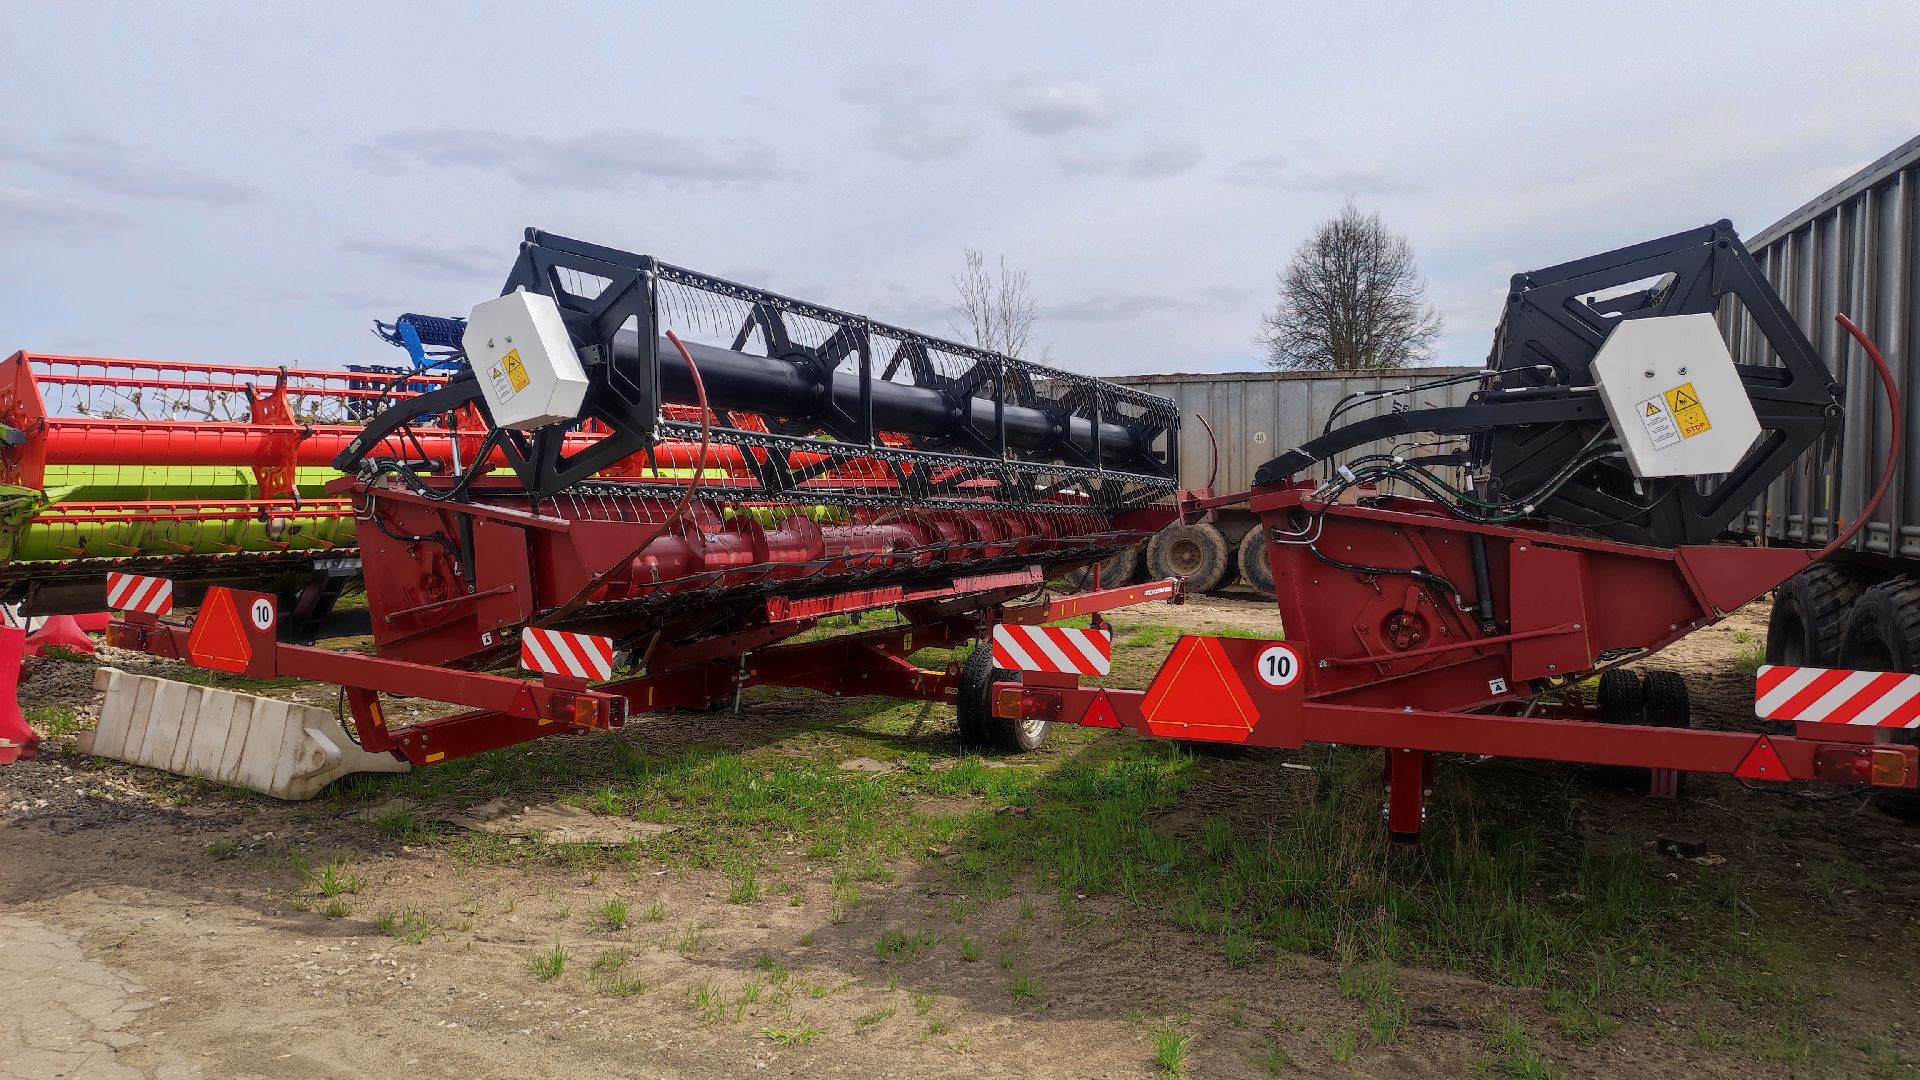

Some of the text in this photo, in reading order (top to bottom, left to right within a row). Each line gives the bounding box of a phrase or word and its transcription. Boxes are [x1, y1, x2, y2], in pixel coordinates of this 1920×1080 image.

[1685, 422, 1706, 434] STOP
[256, 605, 269, 622] 10
[1266, 655, 1290, 678] 10
